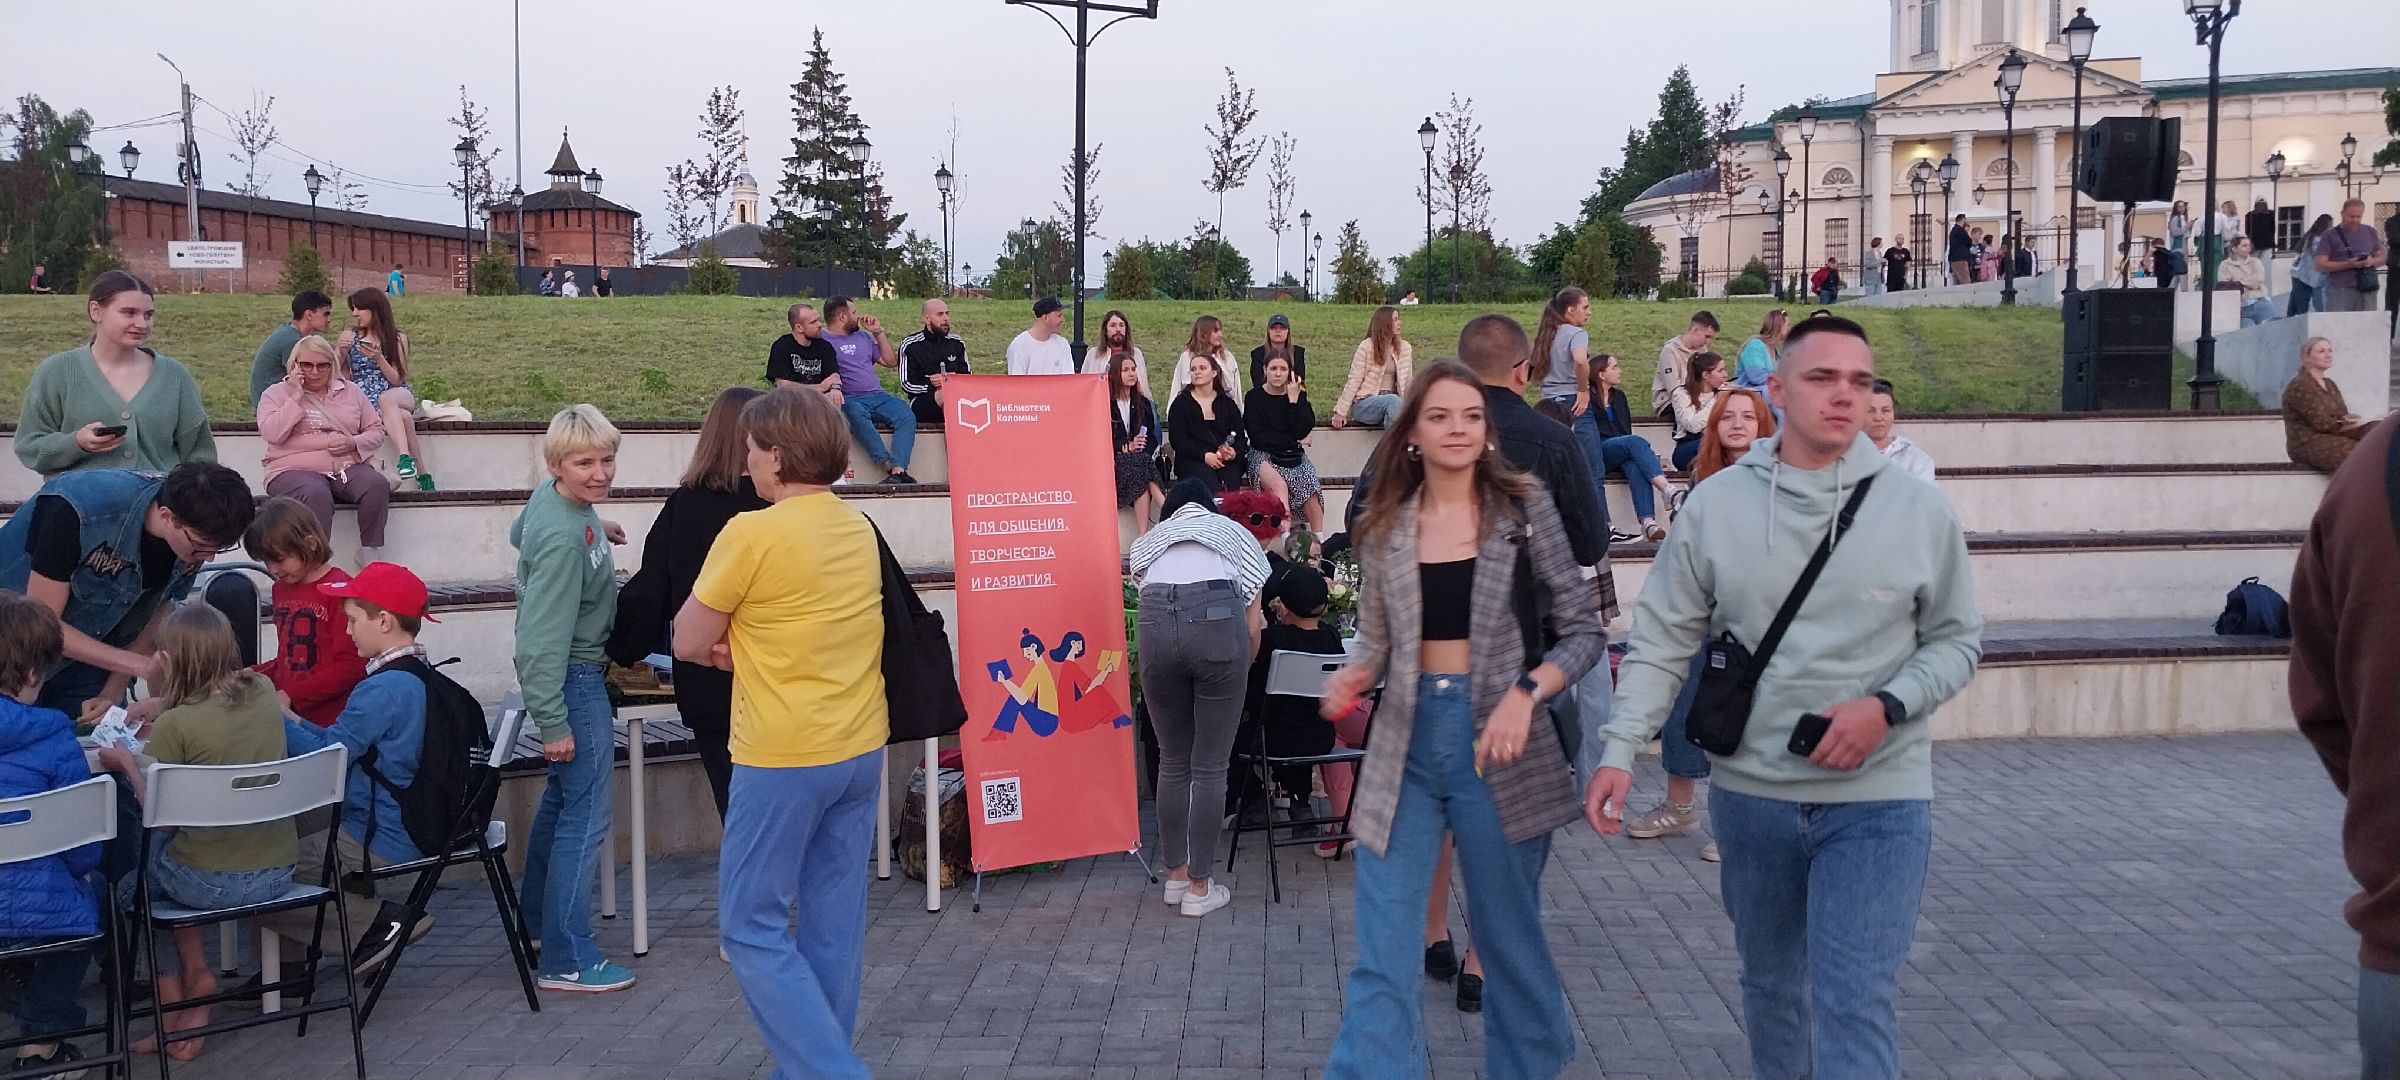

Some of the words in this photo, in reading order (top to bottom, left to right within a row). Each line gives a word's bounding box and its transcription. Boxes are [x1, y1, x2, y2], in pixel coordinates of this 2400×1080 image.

[996, 403, 1051, 413] Библиотеки
[996, 413, 1038, 422] Коломны
[967, 490, 1073, 506] ПРОСТРАНСТВО
[968, 521, 996, 535] ДЛЯ
[999, 518, 1070, 533] ОБЩЕНИЯ,
[970, 546, 1056, 562] ТВОРЧЕСТВА
[971, 577, 981, 590] И
[984, 573, 1057, 588] РАЗВИТИЯ.
[274, 607, 318, 672] 78
